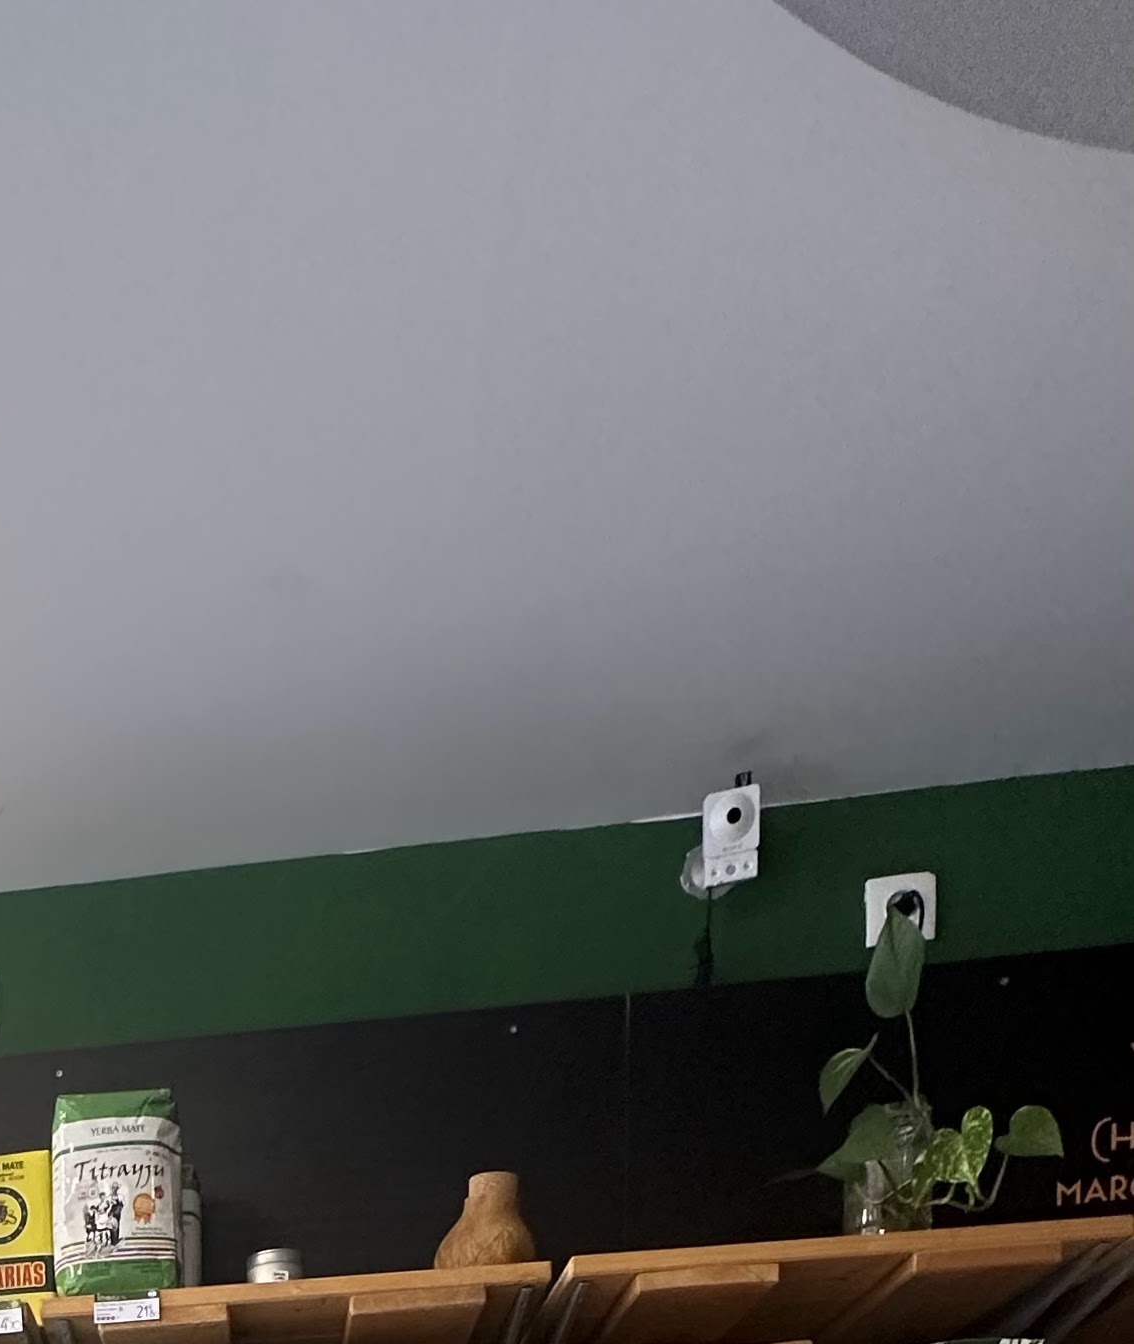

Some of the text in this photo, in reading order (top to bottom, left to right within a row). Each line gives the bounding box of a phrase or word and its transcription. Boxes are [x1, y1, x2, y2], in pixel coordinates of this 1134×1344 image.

[91, 1123, 145, 1136] YERBA MATE
[2, 1160, 24, 1171] MATE
[74, 1157, 164, 1188] Titrayju
[1057, 1174, 1134, 1207] MAR
